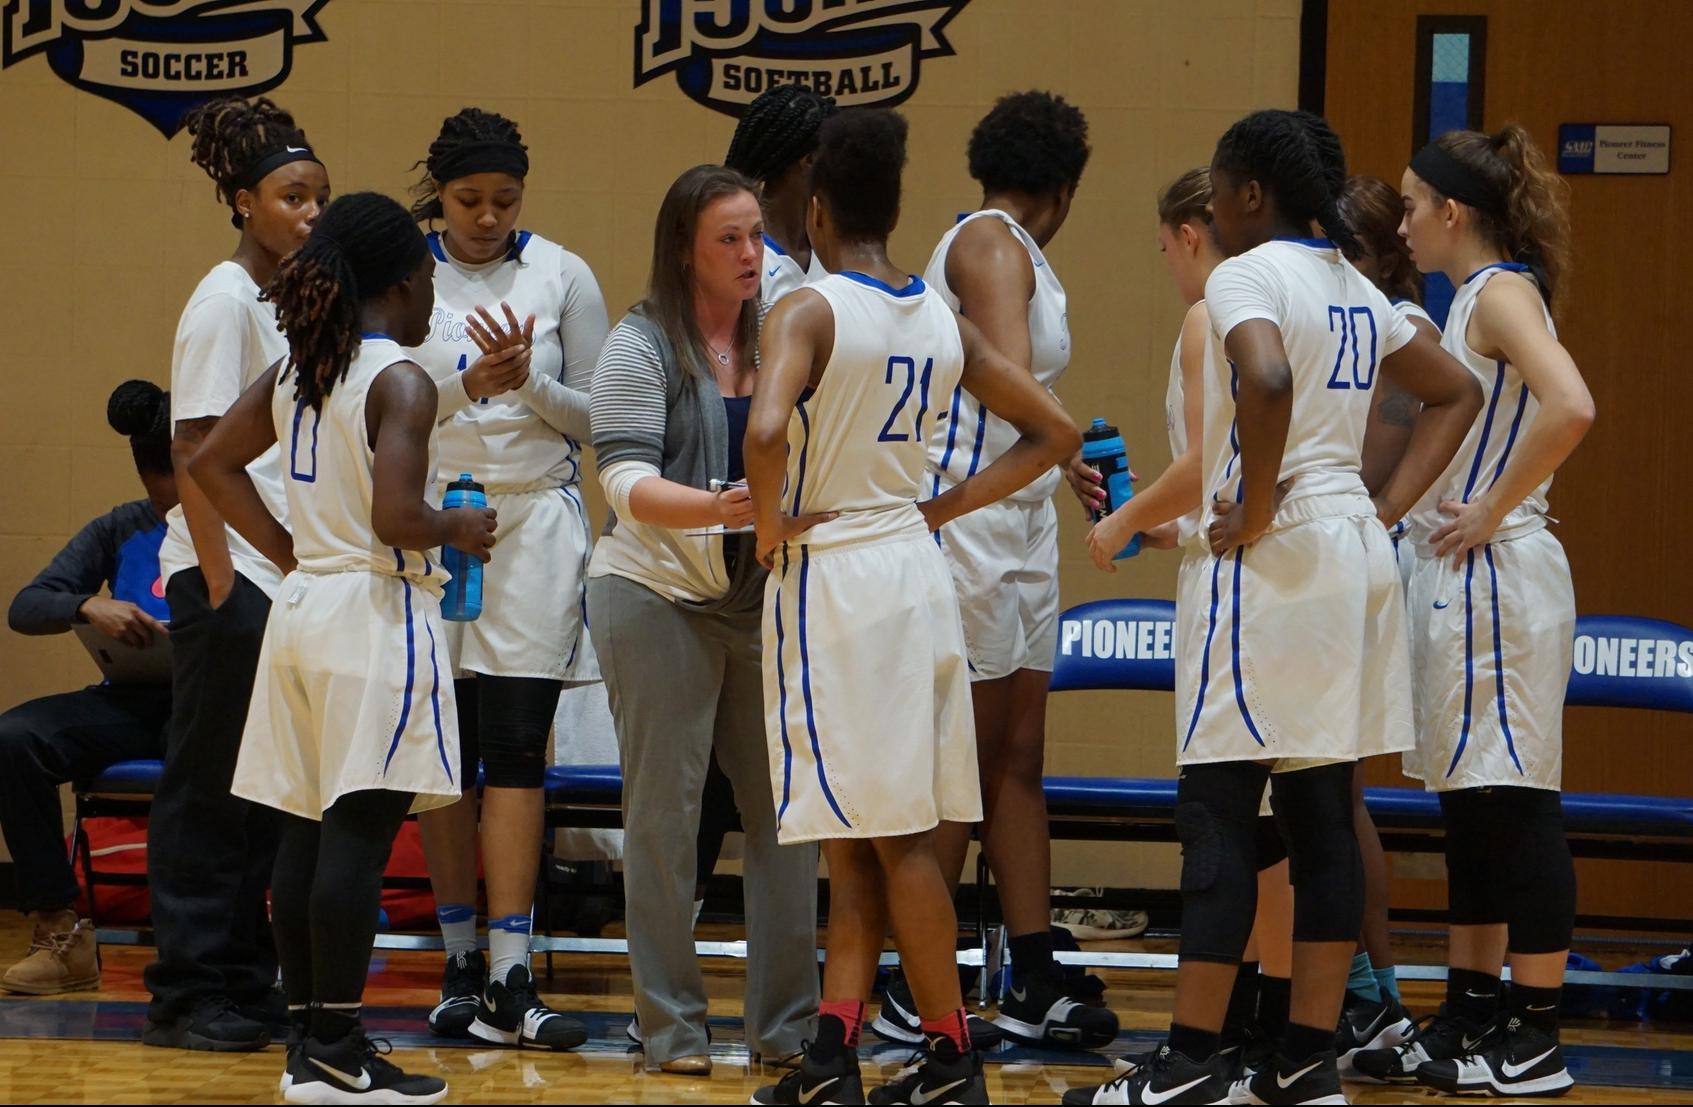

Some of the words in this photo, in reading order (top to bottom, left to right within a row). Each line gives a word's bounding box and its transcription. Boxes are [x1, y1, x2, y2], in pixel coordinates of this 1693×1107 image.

[120, 50, 249, 80] SOCCER
[723, 61, 901, 97] SOFTBALL
[1617, 152, 1647, 160] Center
[1327, 305, 1377, 390] 20
[877, 356, 933, 442] 21
[1061, 619, 1176, 660] PIONEE
